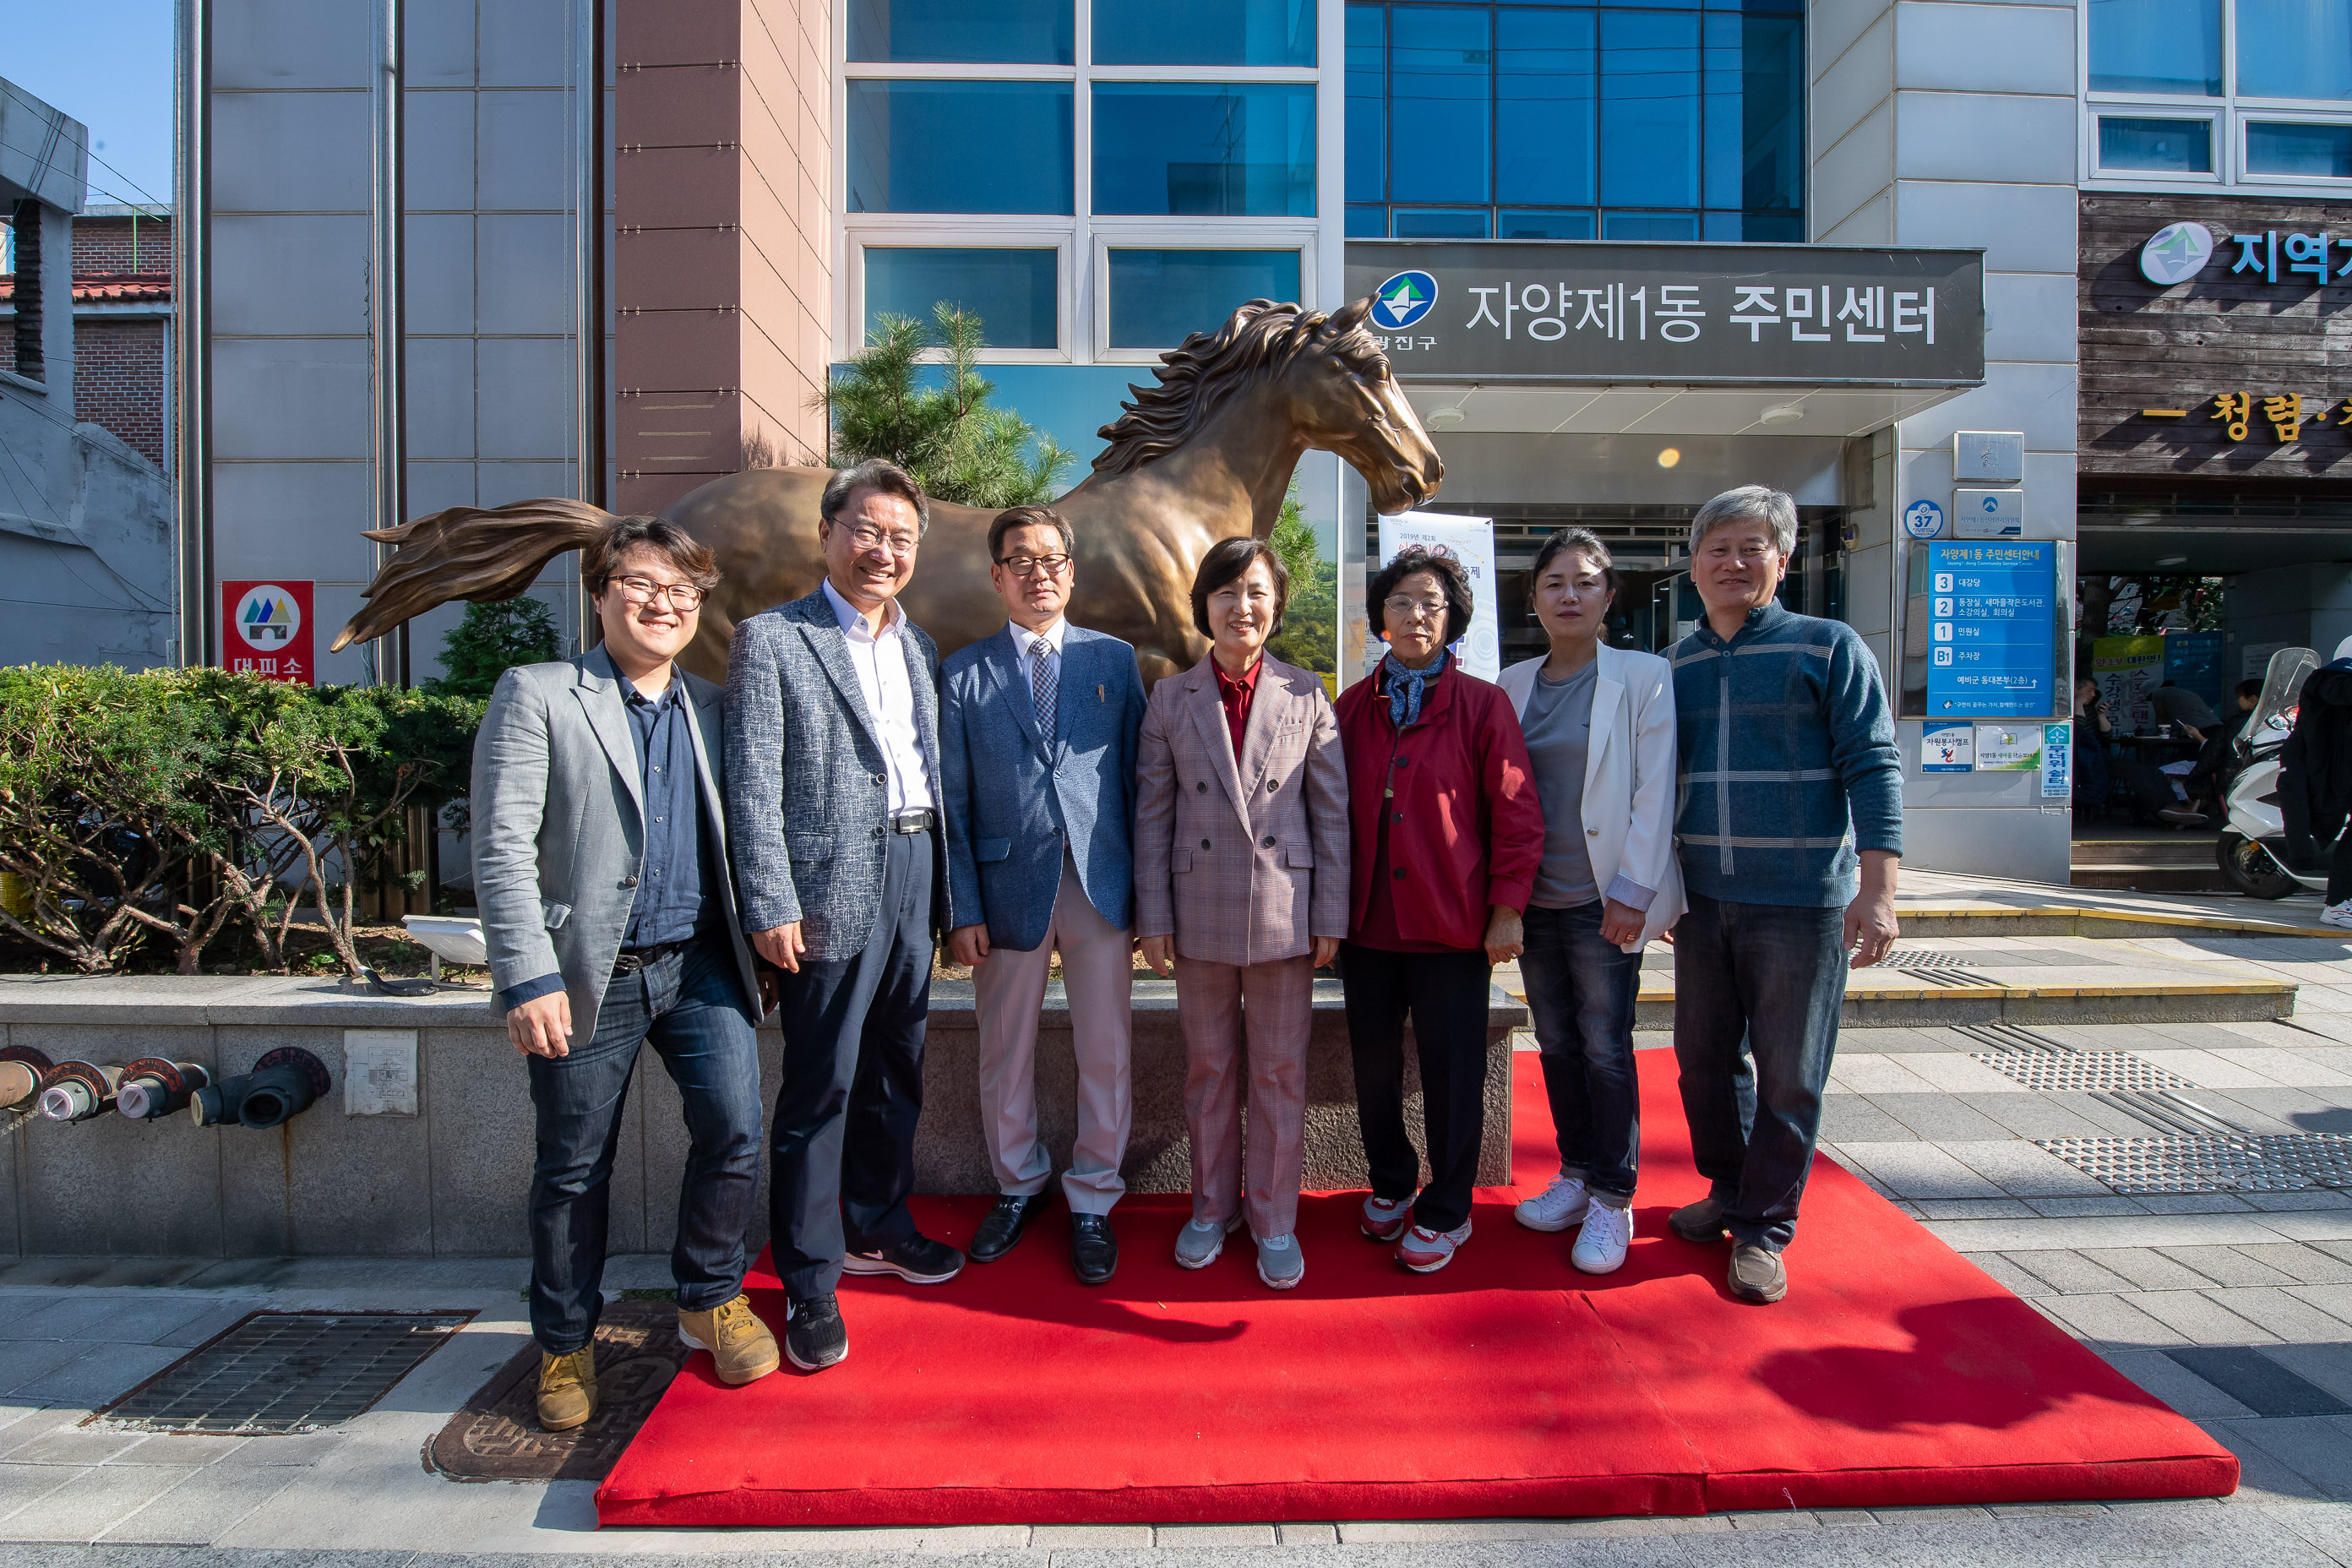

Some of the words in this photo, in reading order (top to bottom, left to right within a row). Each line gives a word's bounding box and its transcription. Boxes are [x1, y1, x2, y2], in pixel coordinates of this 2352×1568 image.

[1466, 281, 1707, 343] 자양제1동
[1729, 284, 1936, 346] 주민센터
[1914, 515, 1934, 528] 37
[1422, 534, 1437, 542] 제2회
[1941, 548, 1983, 561] 자양제1동
[1985, 548, 2039, 562] 주민센터안내
[1940, 576, 1948, 589] 3
[1957, 579, 1981, 587] 대강당
[1940, 601, 1948, 614] 2
[1958, 598, 1983, 608] 동장실,
[1957, 608, 1990, 618] 소강의실,
[1993, 608, 2015, 618] 회의실
[1940, 625, 1946, 638] 1
[1957, 627, 1980, 637] 민원실
[1937, 650, 1950, 662] B1
[1957, 651, 1980, 662] 주차장
[233, 657, 302, 676] 대피소
[1957, 675, 1979, 685] 예비군
[1981, 675, 2028, 686] 동대본부(2층)
[1927, 738, 1969, 747] 자원봉사캠프
